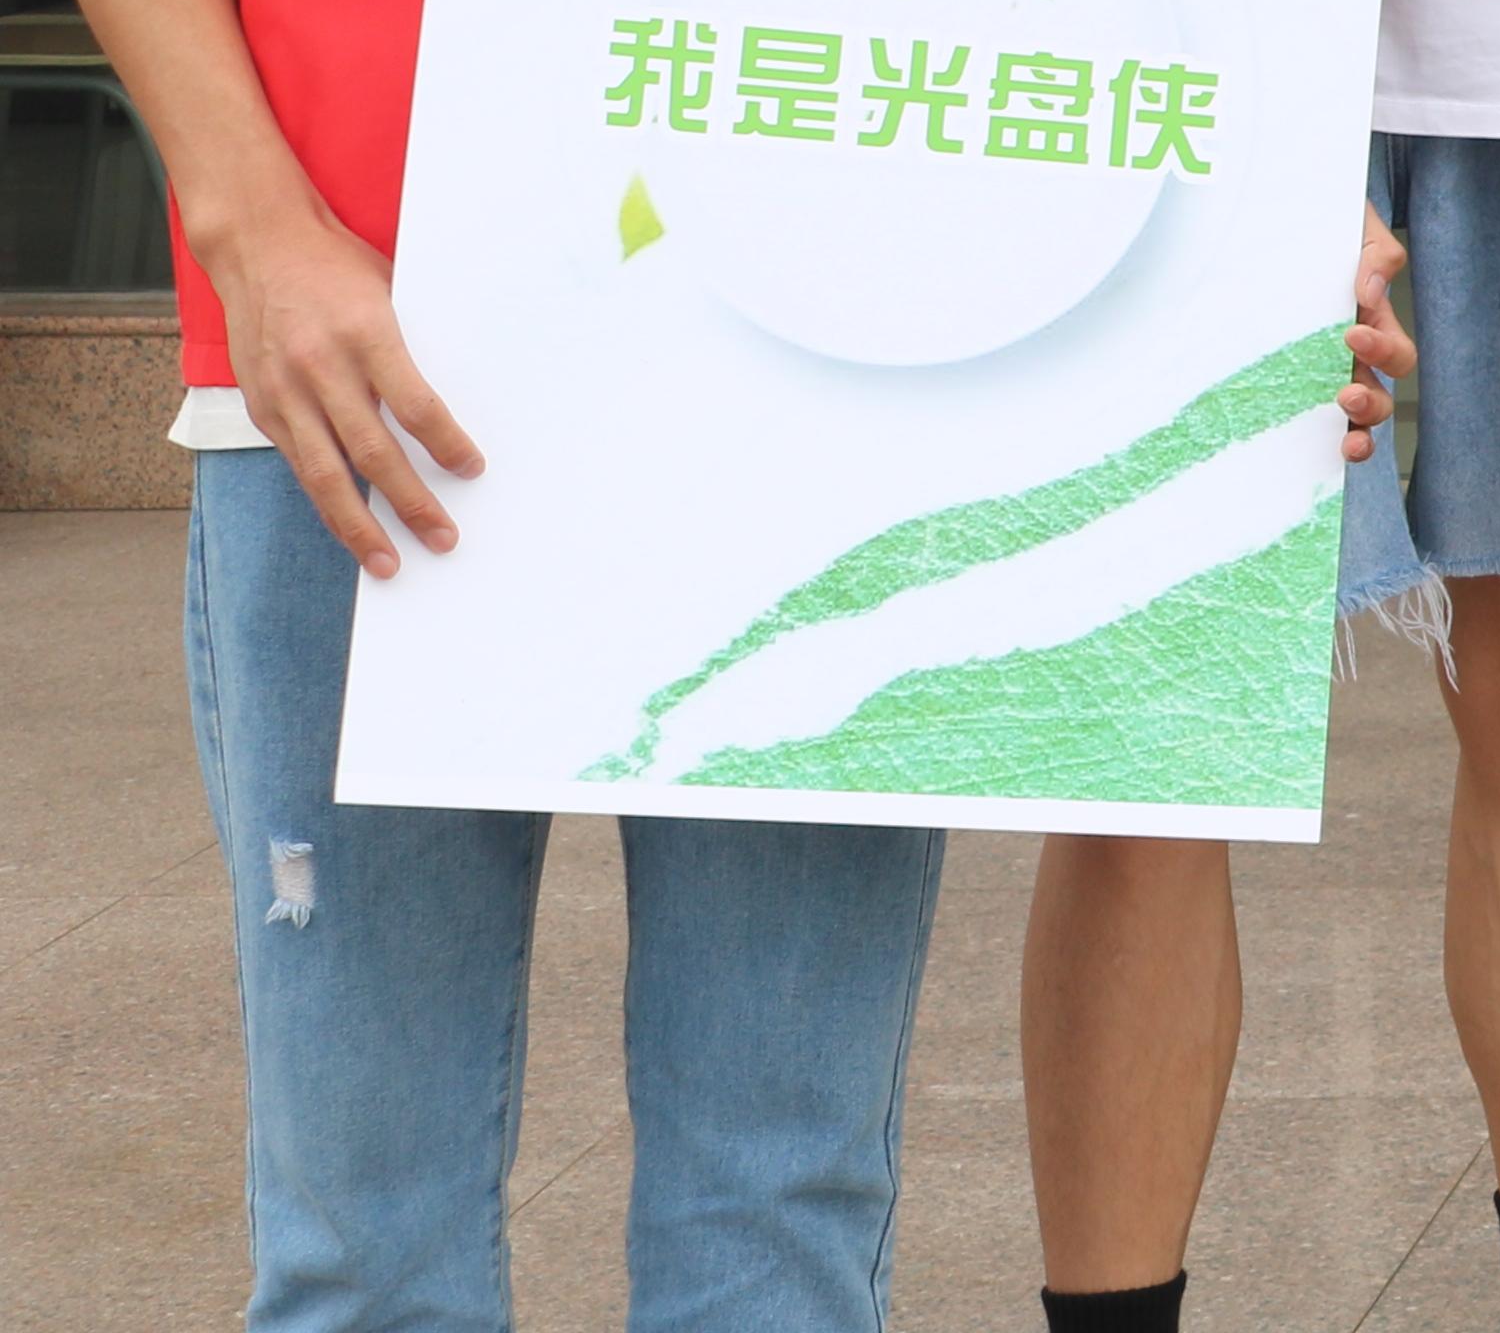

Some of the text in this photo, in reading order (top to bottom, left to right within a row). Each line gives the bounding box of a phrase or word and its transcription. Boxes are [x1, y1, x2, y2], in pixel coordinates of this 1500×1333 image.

[604, 17, 1221, 176] 我是光盘侠
